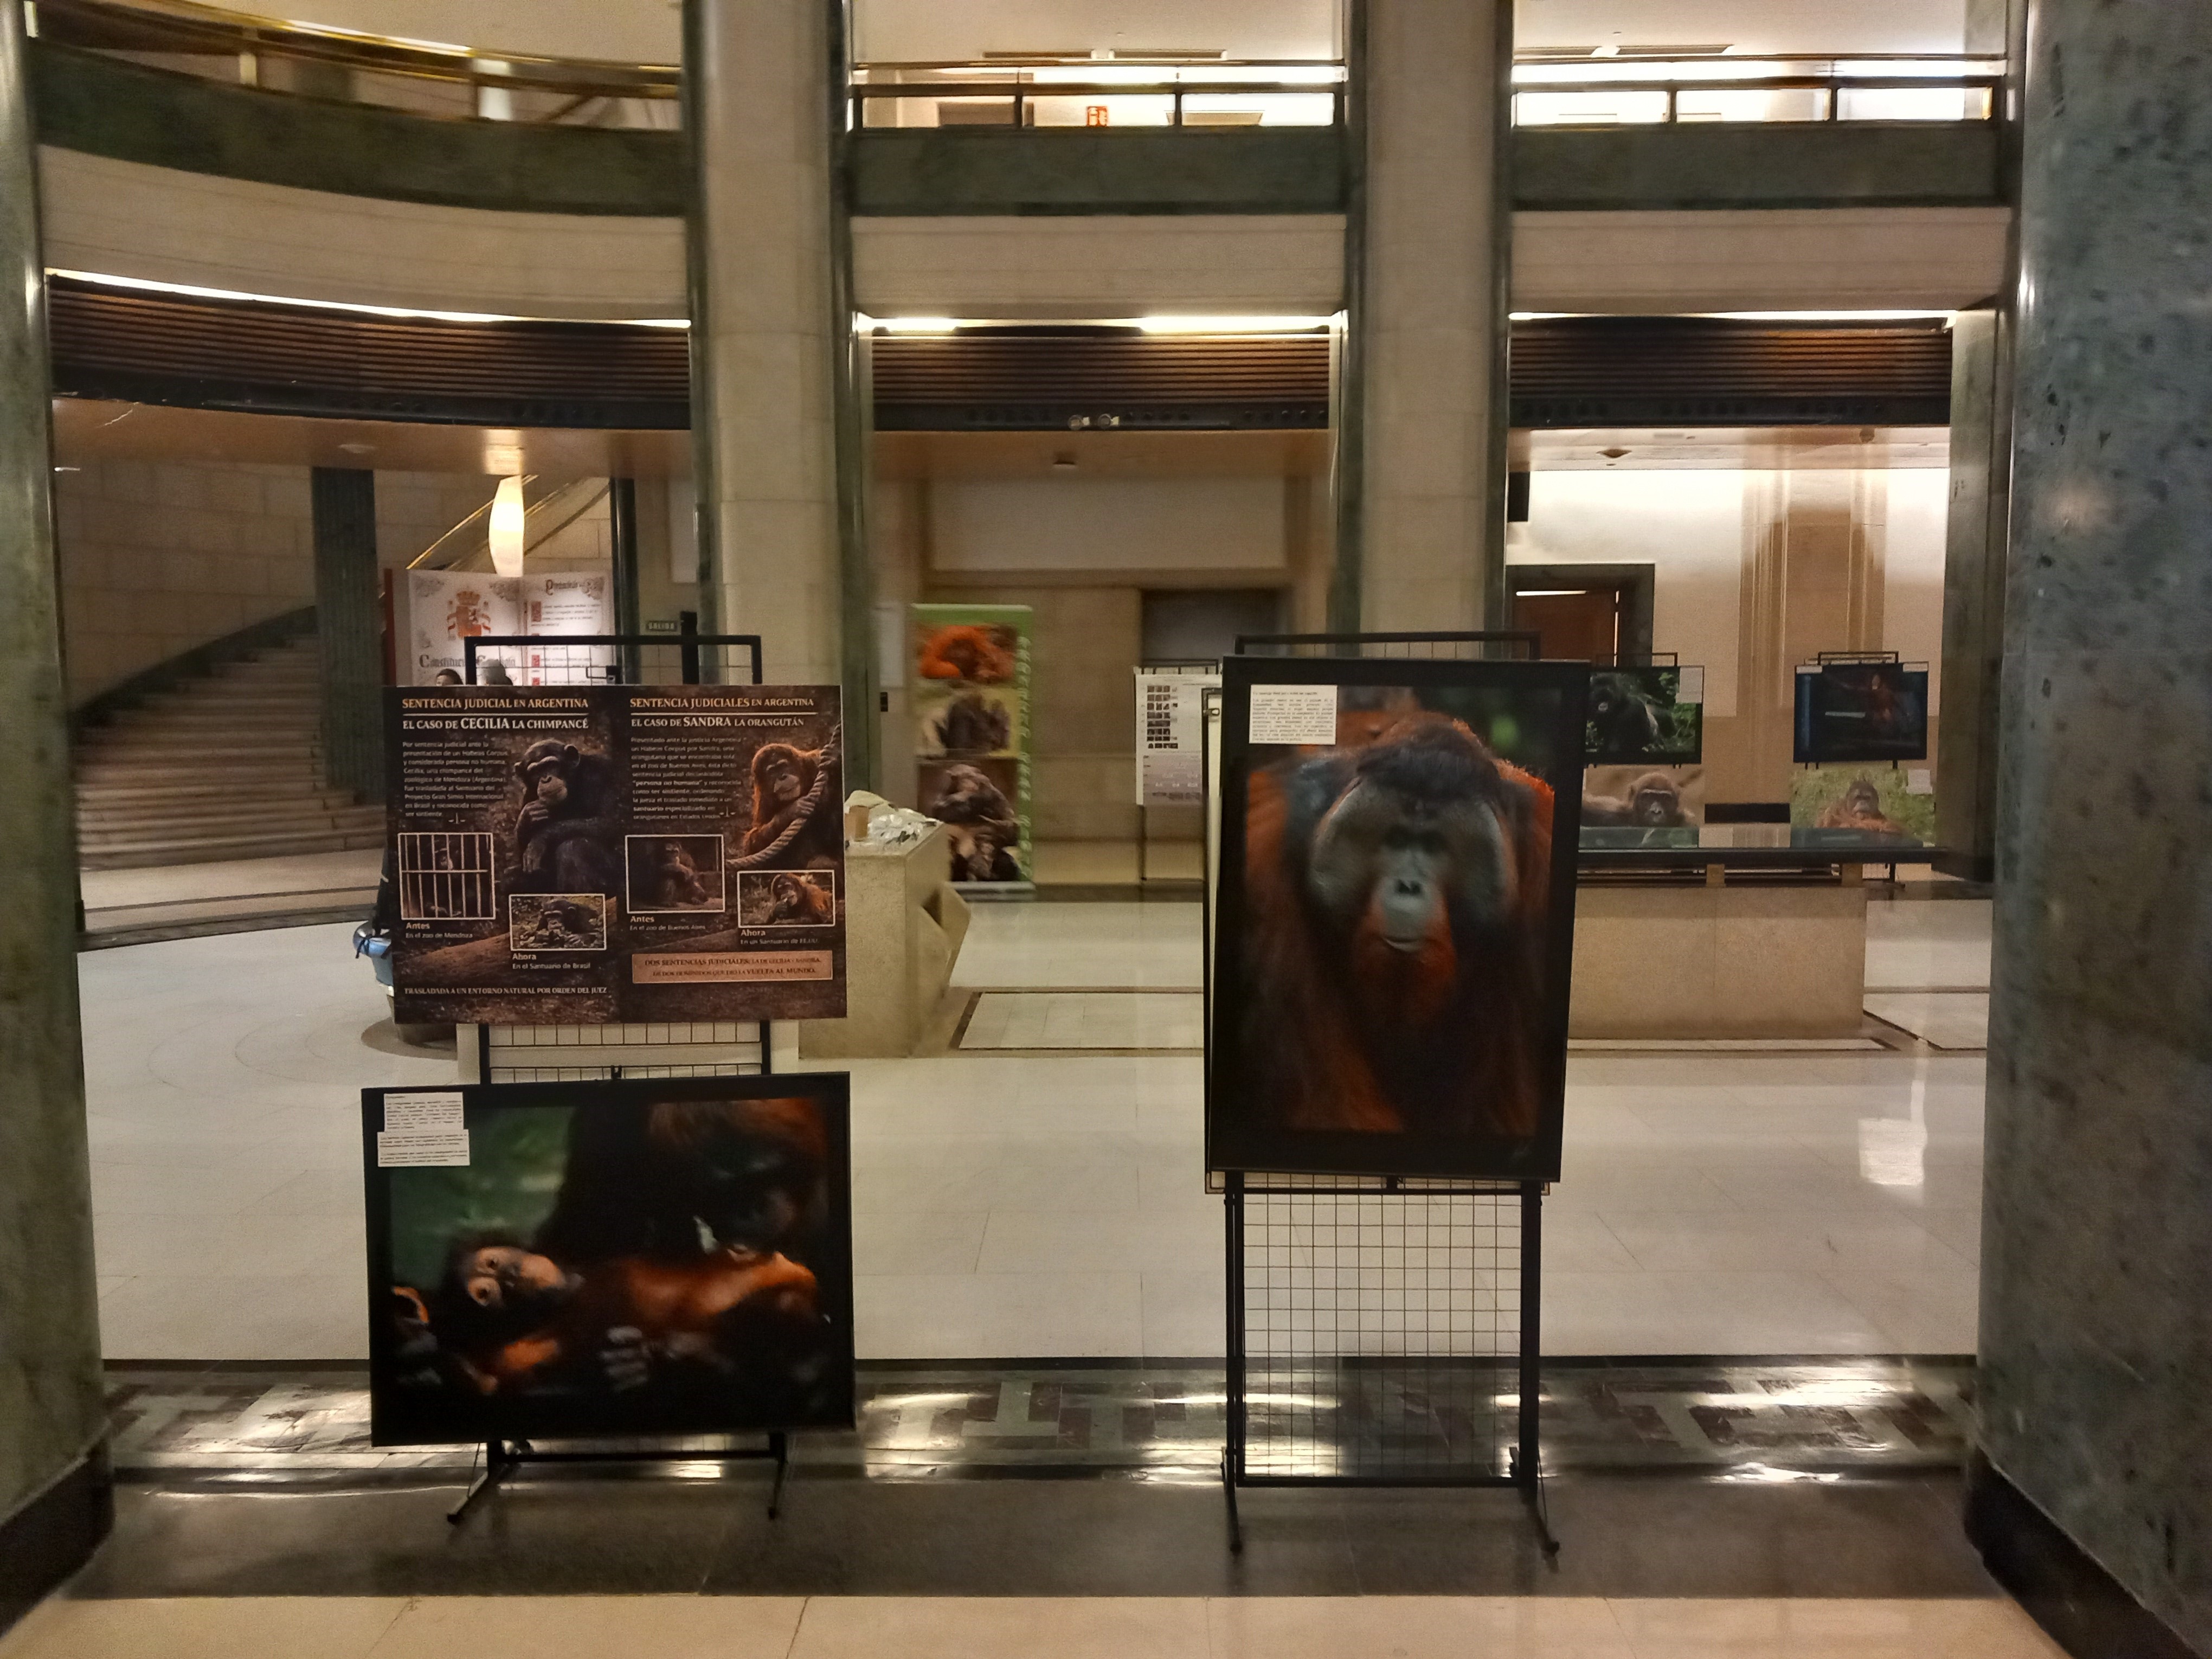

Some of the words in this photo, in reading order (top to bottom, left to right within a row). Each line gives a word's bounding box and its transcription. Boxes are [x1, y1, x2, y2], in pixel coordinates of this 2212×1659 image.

[402, 699, 461, 708] SENTENCIA
[464, 699, 511, 710] JUDICIAL
[528, 699, 588, 708] ARGENTINA
[630, 698, 688, 708] SENTENCIA
[691, 698, 749, 709] JUDICIALES
[764, 698, 813, 706] ARGENTINA
[403, 721, 415, 729] EL
[416, 720, 442, 729] CASO
[446, 721, 458, 729] DE
[460, 718, 510, 729] CECILIA
[512, 720, 525, 729] LA
[528, 717, 589, 729] CHIMPANCÉ
[644, 718, 667, 726] CASO
[684, 717, 730, 727] SANDRA
[747, 717, 804, 726] ORANGUTÁN
